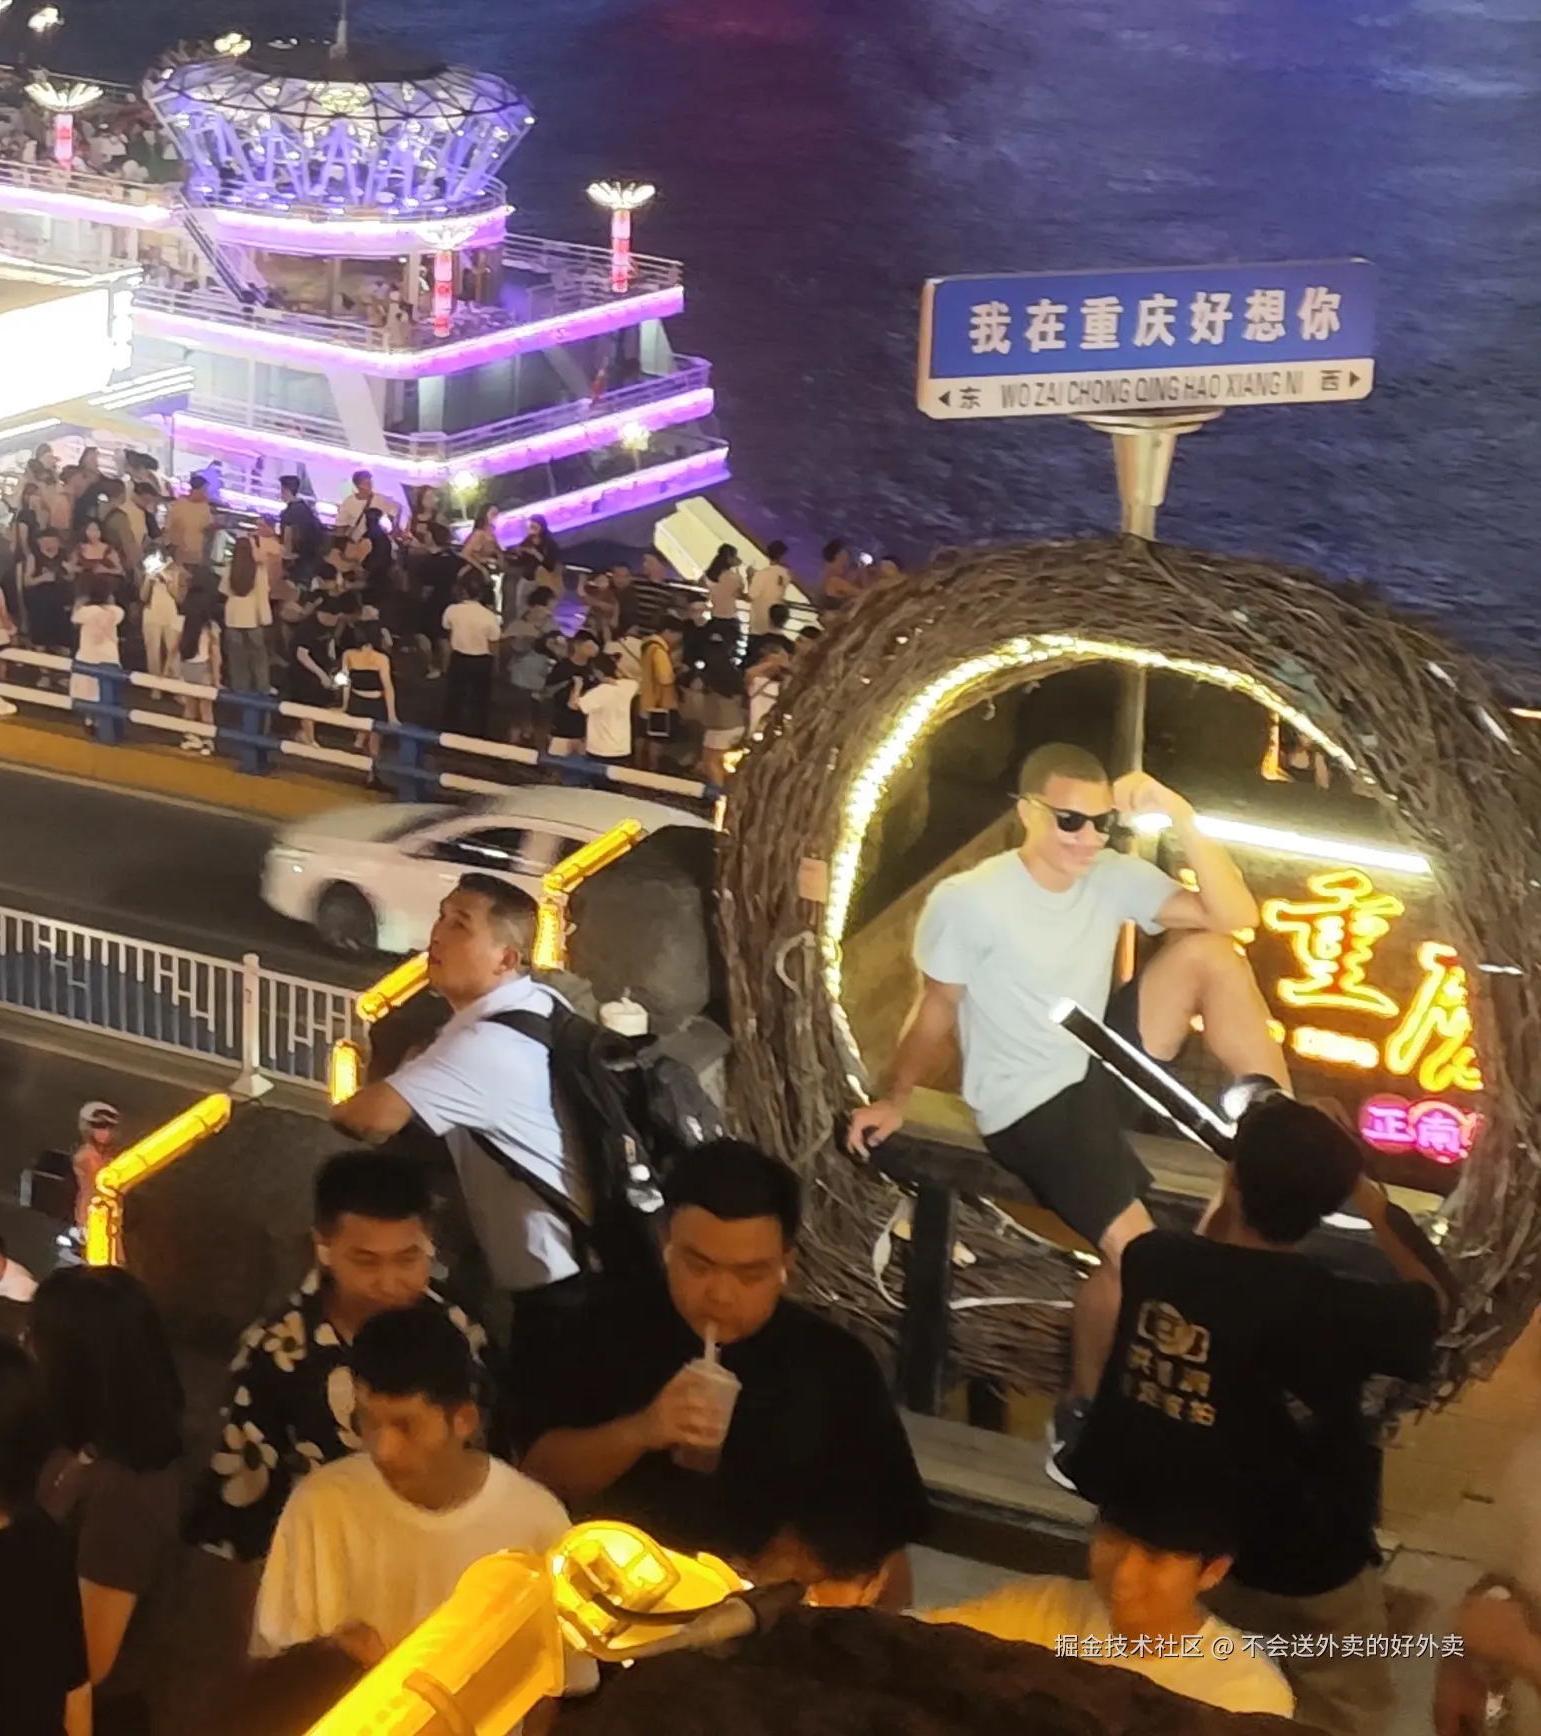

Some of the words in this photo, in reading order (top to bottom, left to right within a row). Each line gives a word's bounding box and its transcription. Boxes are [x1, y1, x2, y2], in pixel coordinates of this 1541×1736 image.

[968, 286, 1343, 355] 我在重庆好想你
[1320, 369, 1342, 392] 西
[958, 385, 982, 410] 东
